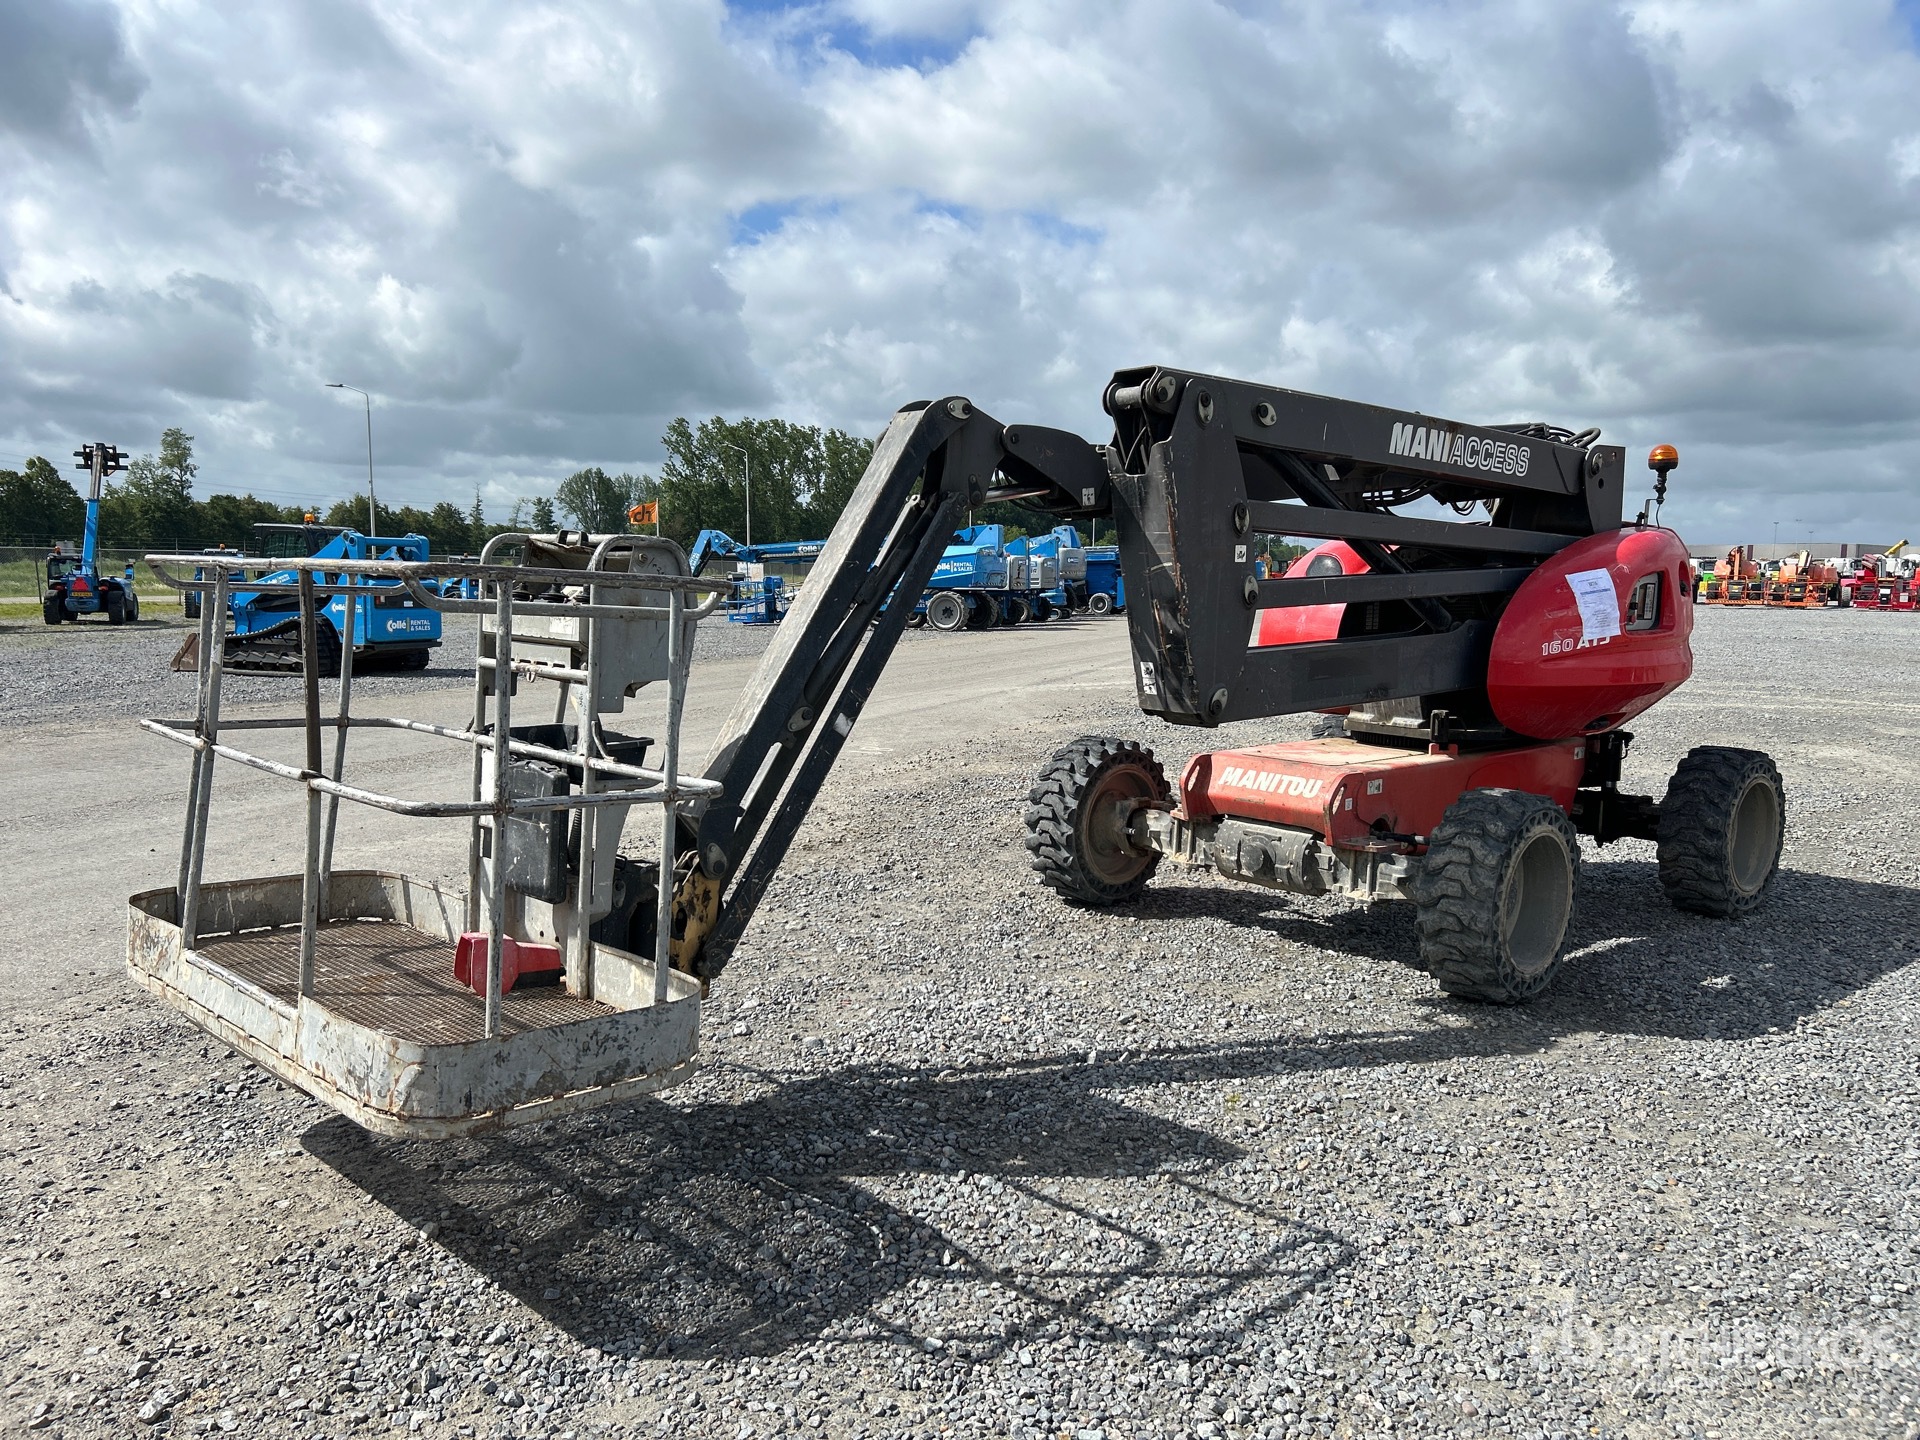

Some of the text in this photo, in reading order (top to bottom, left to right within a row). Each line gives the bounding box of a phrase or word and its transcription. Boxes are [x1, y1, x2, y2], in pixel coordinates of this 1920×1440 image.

[1389, 422, 1530, 477] MANIACCESS
[1541, 638, 1574, 656] 160
[1218, 766, 1324, 799] MANITOU
